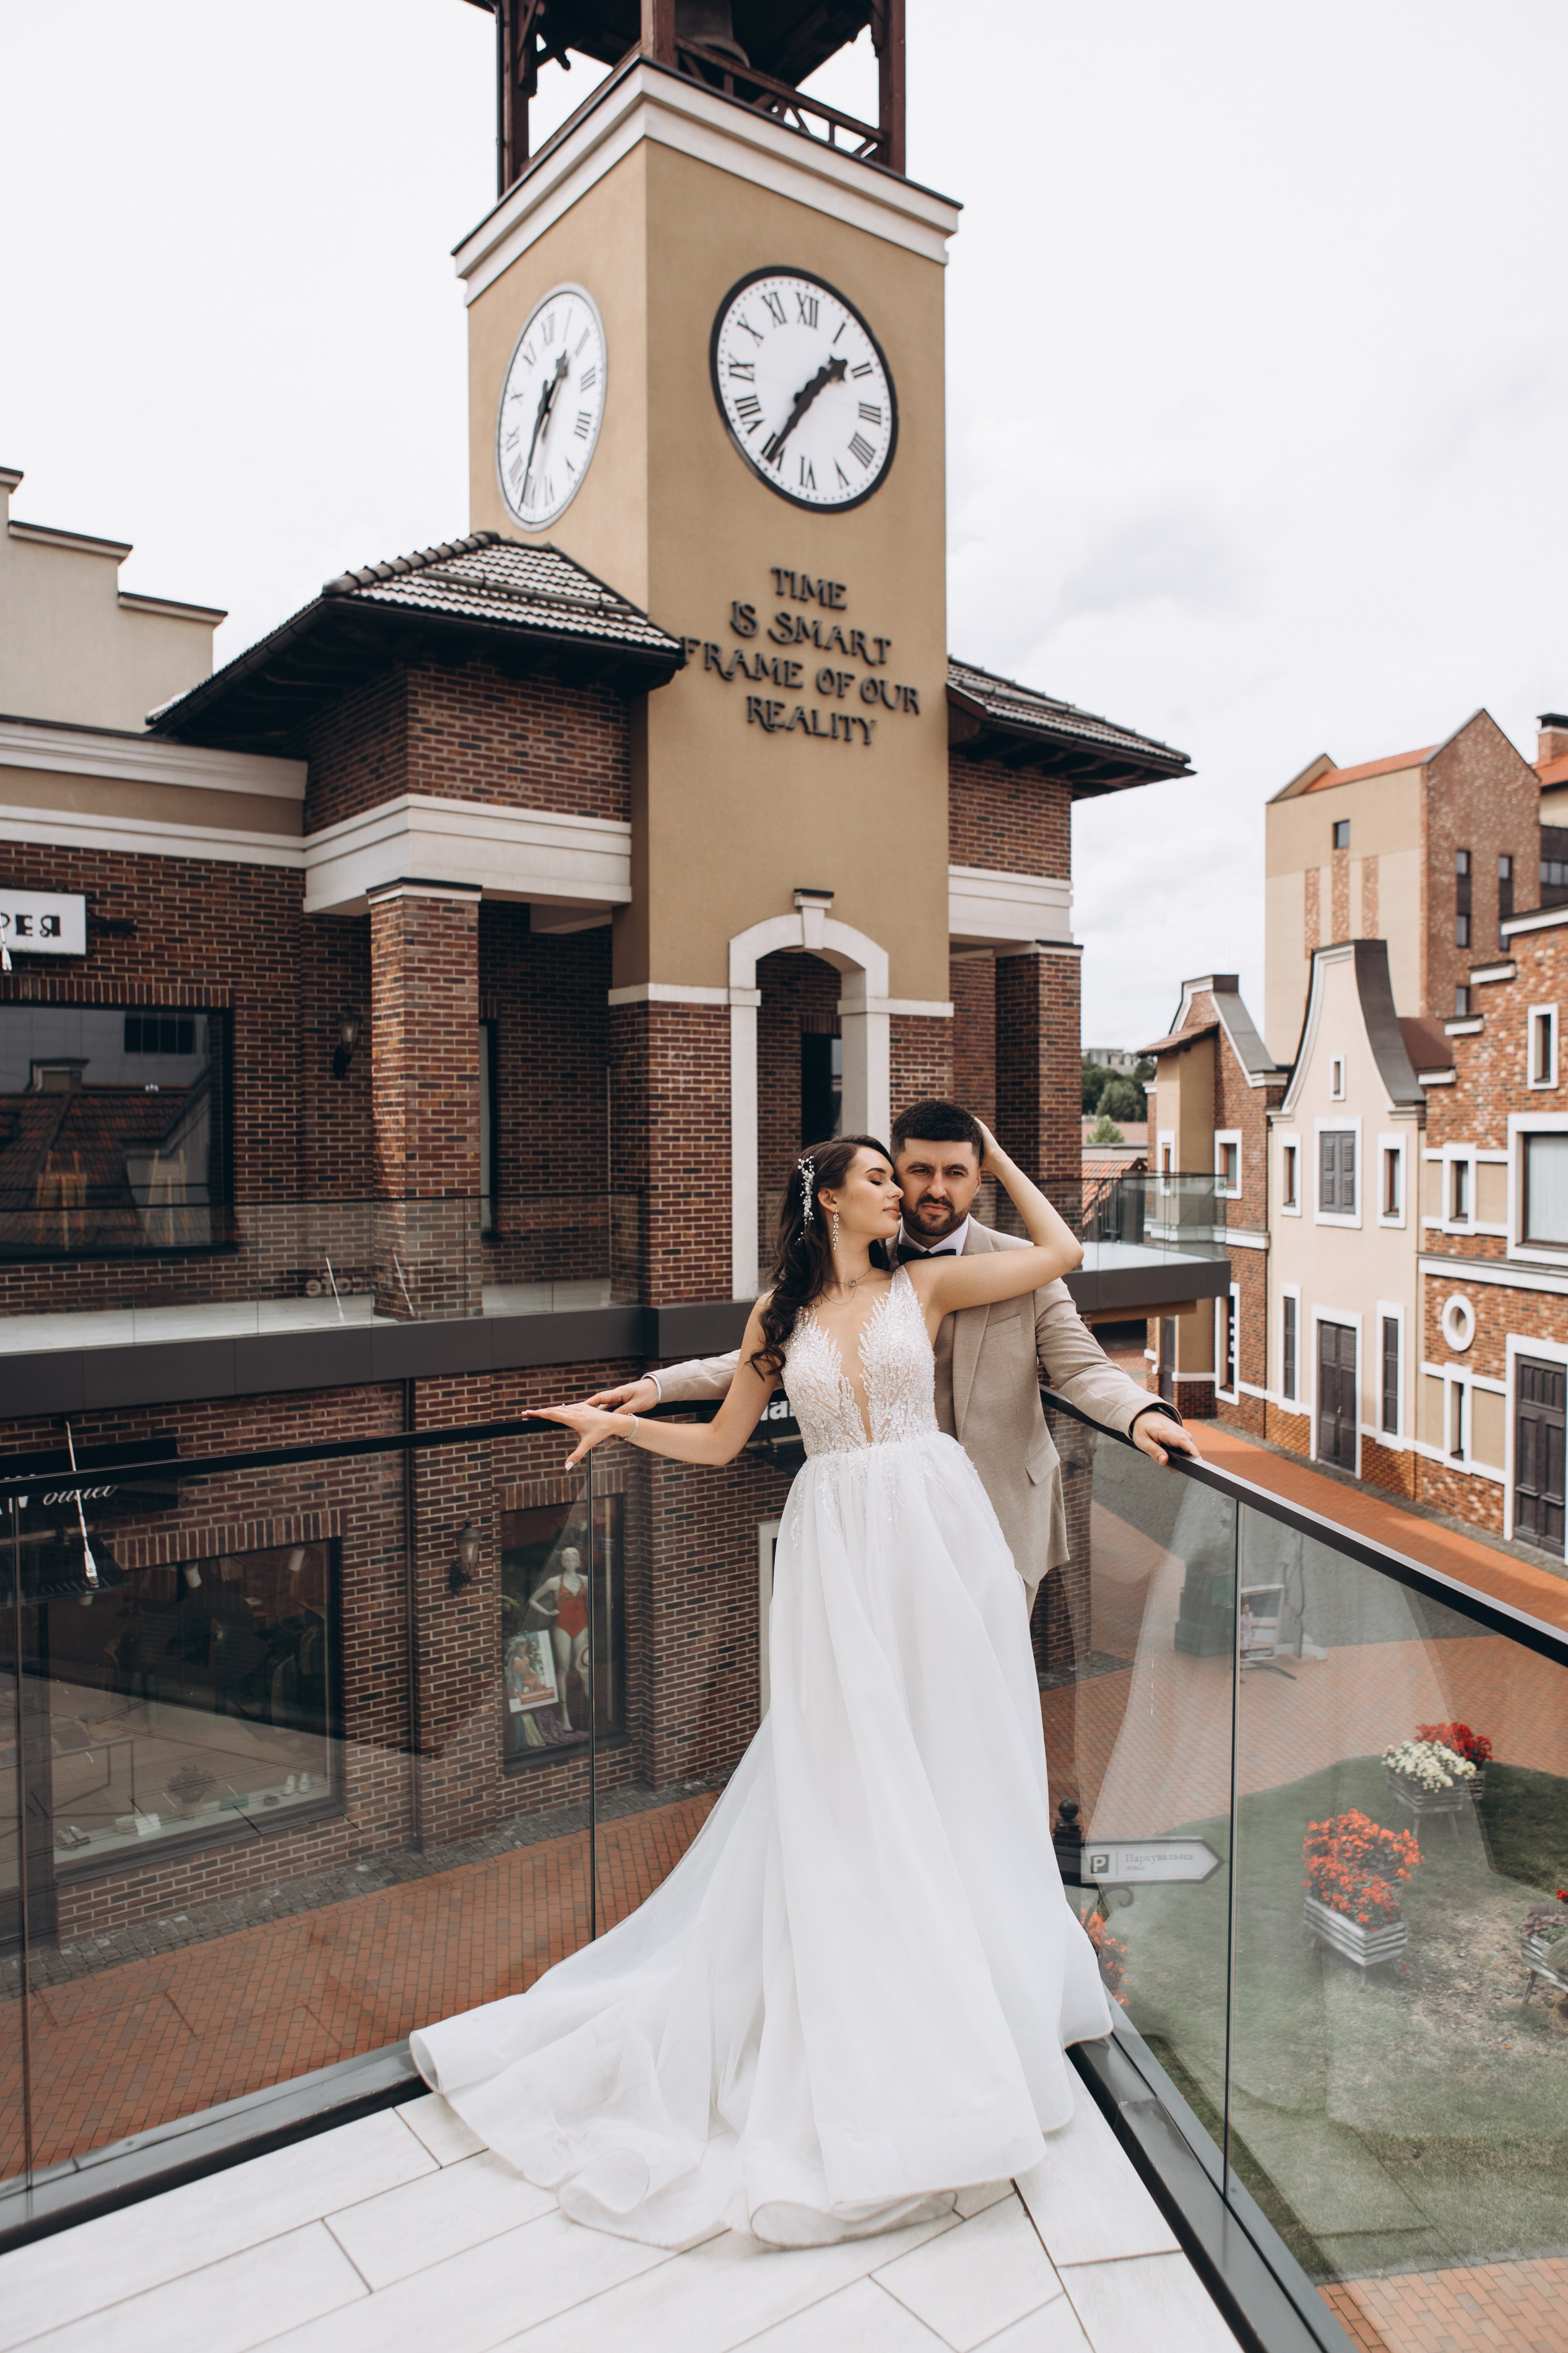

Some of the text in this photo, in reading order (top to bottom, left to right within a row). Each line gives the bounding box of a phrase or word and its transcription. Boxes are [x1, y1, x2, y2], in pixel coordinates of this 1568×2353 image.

[761, 292, 787, 328] XI
[795, 292, 819, 330] XII
[737, 313, 764, 347] X
[833, 323, 846, 344] I
[852, 363, 873, 378] II
[859, 402, 881, 425] III
[761, 433, 786, 472] VI
[771, 567, 847, 610] TIME
[730, 601, 891, 666] IS SMART
[680, 637, 920, 715] FRAME OF OUR
[747, 695, 876, 745] REALITY
